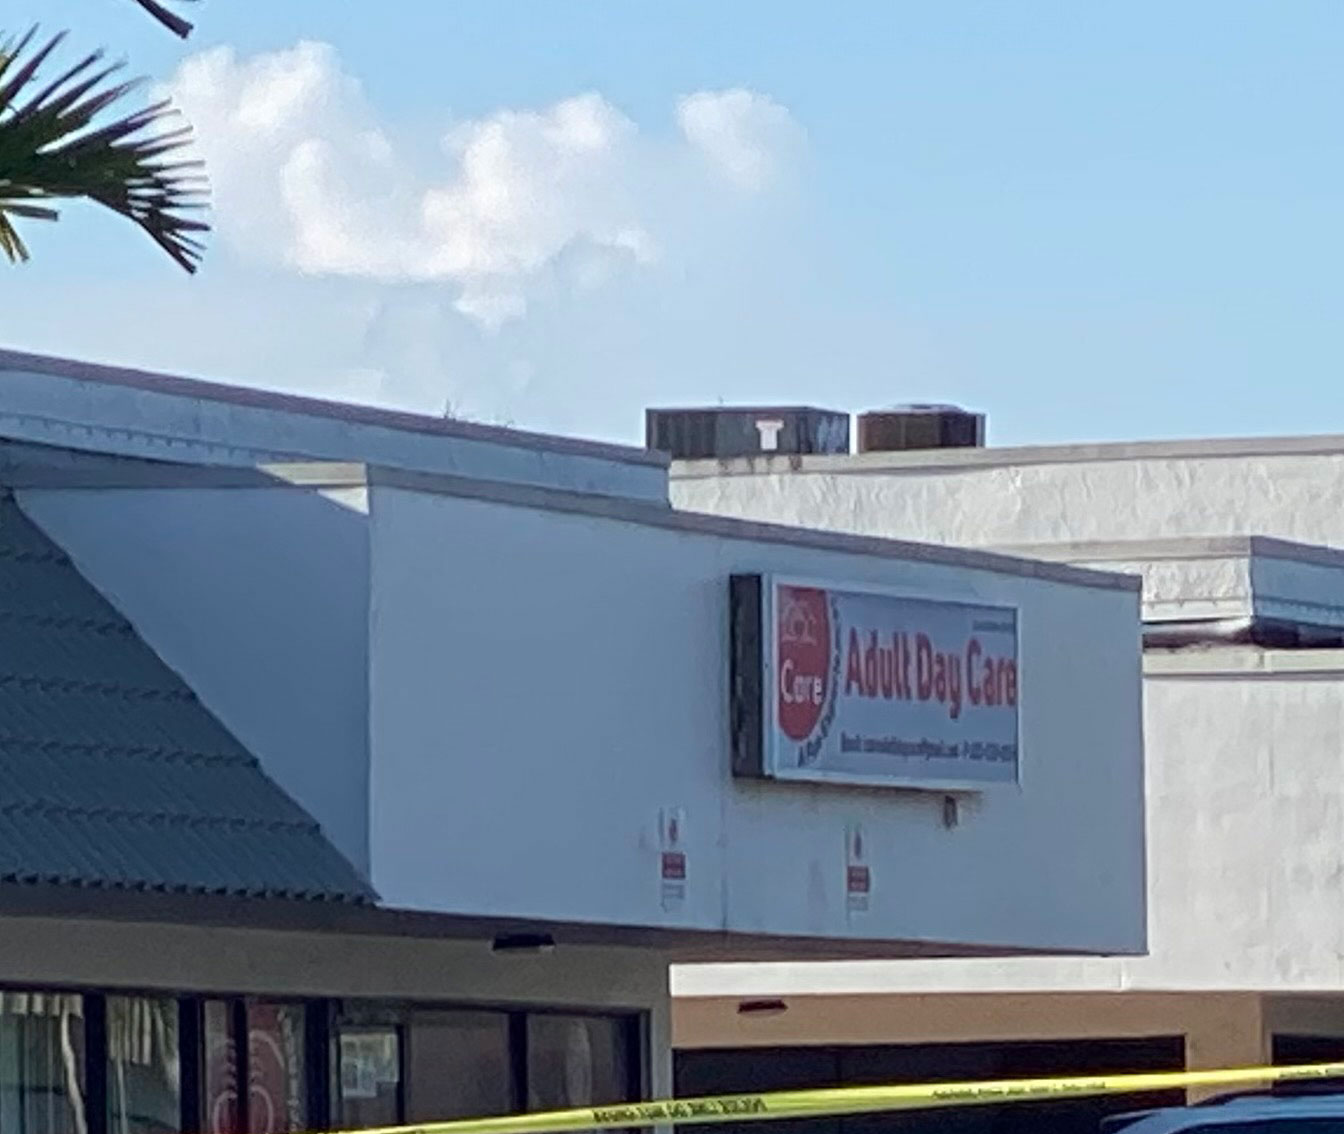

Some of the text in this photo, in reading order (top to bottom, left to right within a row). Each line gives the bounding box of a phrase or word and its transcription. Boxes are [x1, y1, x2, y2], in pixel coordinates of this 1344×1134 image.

[780, 658, 823, 705] Care
[845, 627, 912, 700] Adult
[915, 631, 961, 719] Day
[966, 637, 1017, 707] Care
